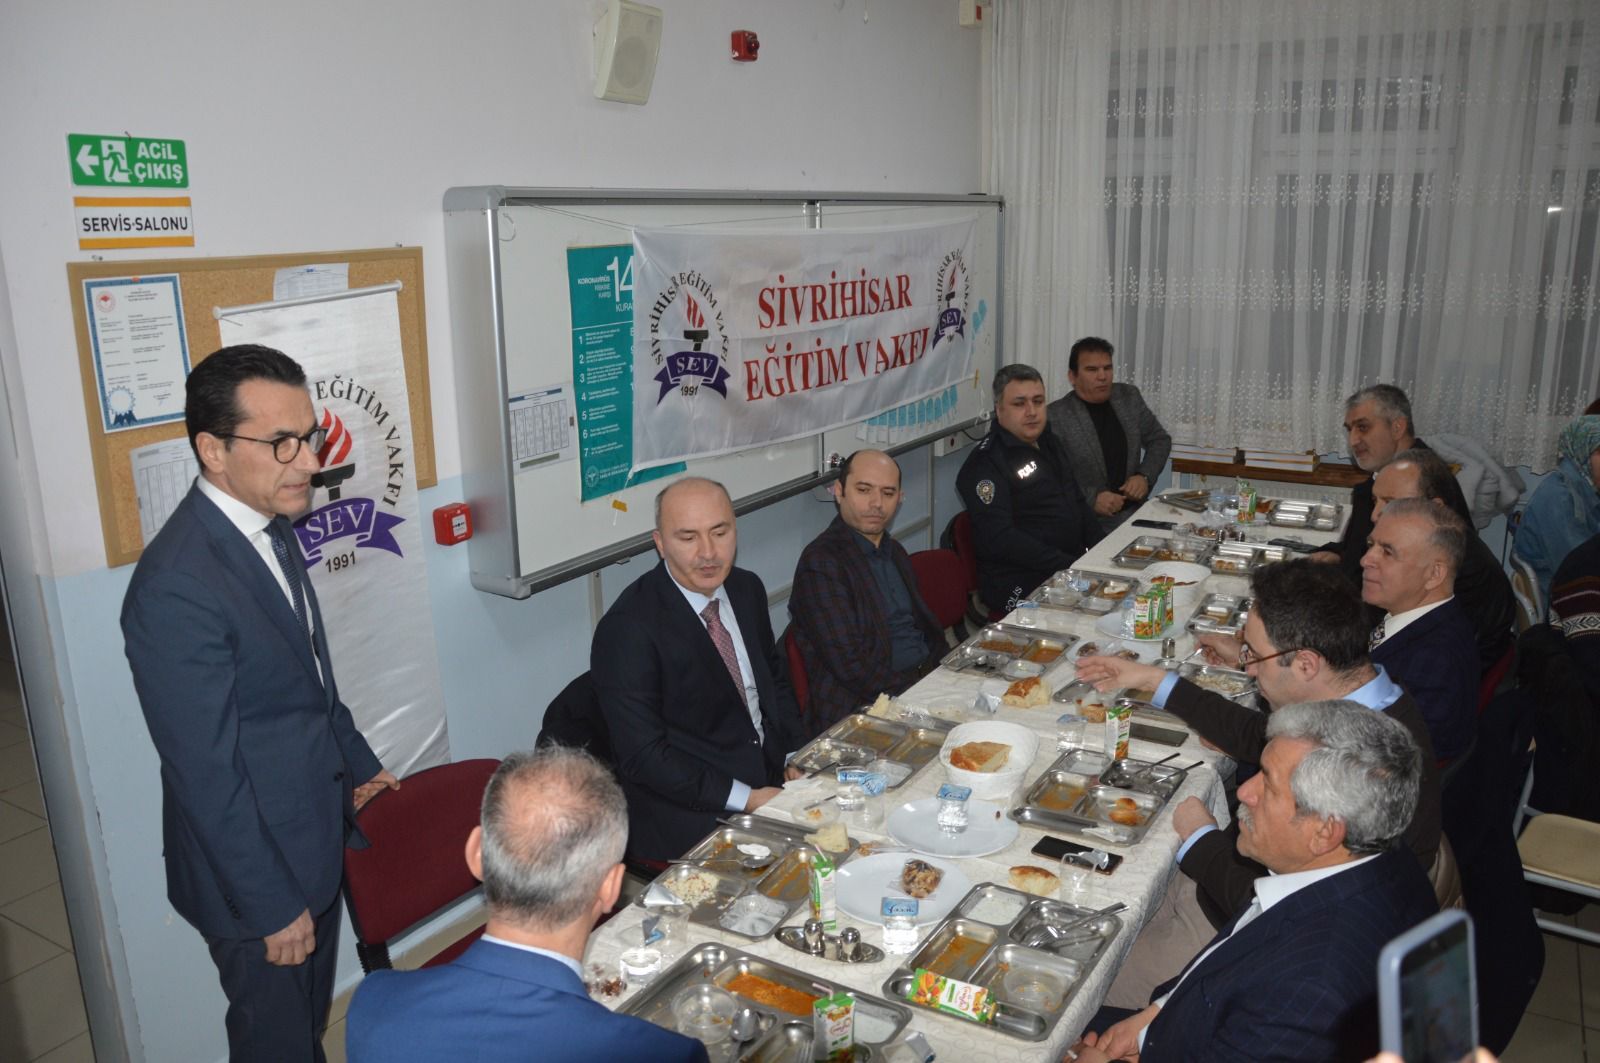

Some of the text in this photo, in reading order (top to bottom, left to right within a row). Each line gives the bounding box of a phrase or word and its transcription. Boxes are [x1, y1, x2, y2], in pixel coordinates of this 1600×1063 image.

[137, 141, 178, 160] ACİL
[134, 162, 184, 184] ÇIKIŞ
[606, 255, 634, 302] 14
[680, 270, 717, 308] EĞİTİM
[615, 302, 634, 312] KURA
[758, 268, 913, 329] SİVRİHİSAR
[579, 354, 585, 364] 2
[676, 356, 714, 374] SEV
[743, 327, 931, 401] EĞİTİM VAKFI
[579, 373, 585, 383] 3
[581, 392, 587, 402] 4
[680, 385, 699, 396] 1991
[582, 411, 587, 420] 5
[315, 375, 404, 508] EĞİTİM VAKFI
[582, 429, 588, 439] 6
[583, 448, 589, 457] 7
[305, 503, 368, 544] SEV
[325, 551, 357, 573] 1991
